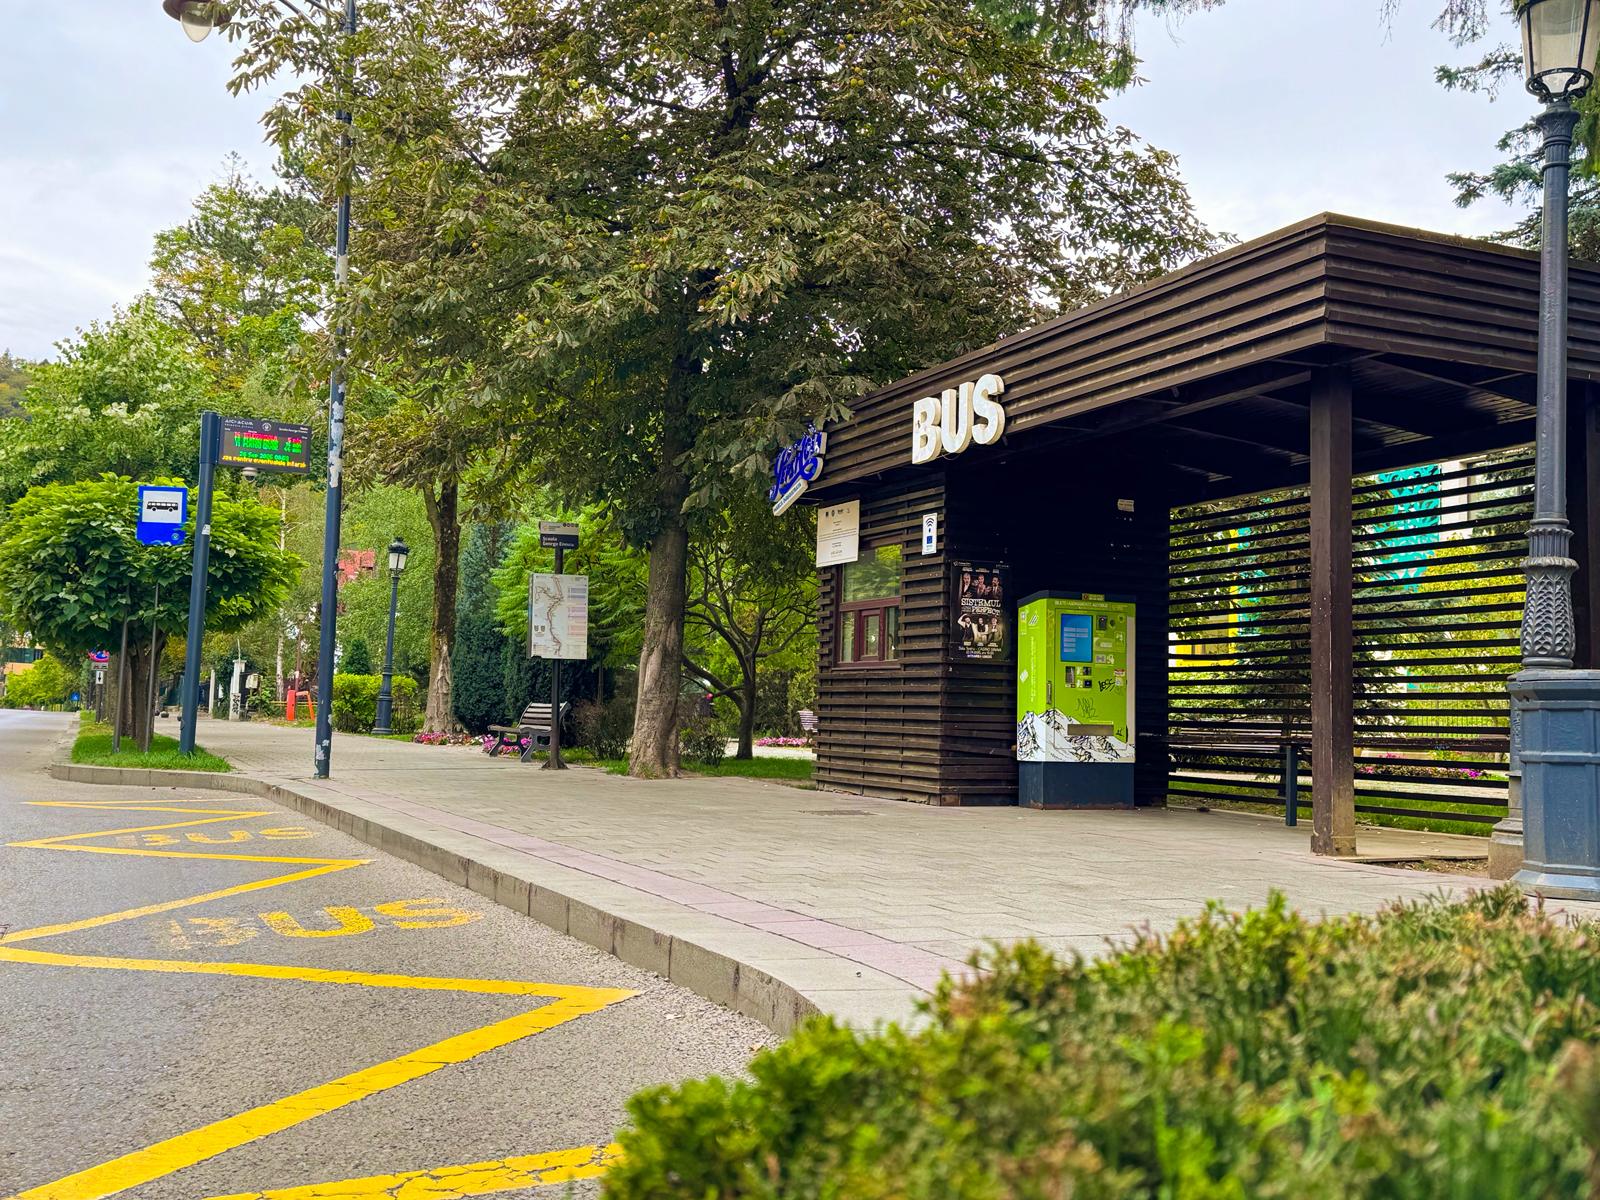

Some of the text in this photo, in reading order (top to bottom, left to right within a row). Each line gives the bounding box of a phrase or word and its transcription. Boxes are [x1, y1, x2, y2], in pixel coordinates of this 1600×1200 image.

[912, 374, 1005, 464] BUS
[961, 598, 1001, 608] SISTEMUL
[971, 605, 1000, 616] PERFECT
[115, 827, 319, 846] BUS
